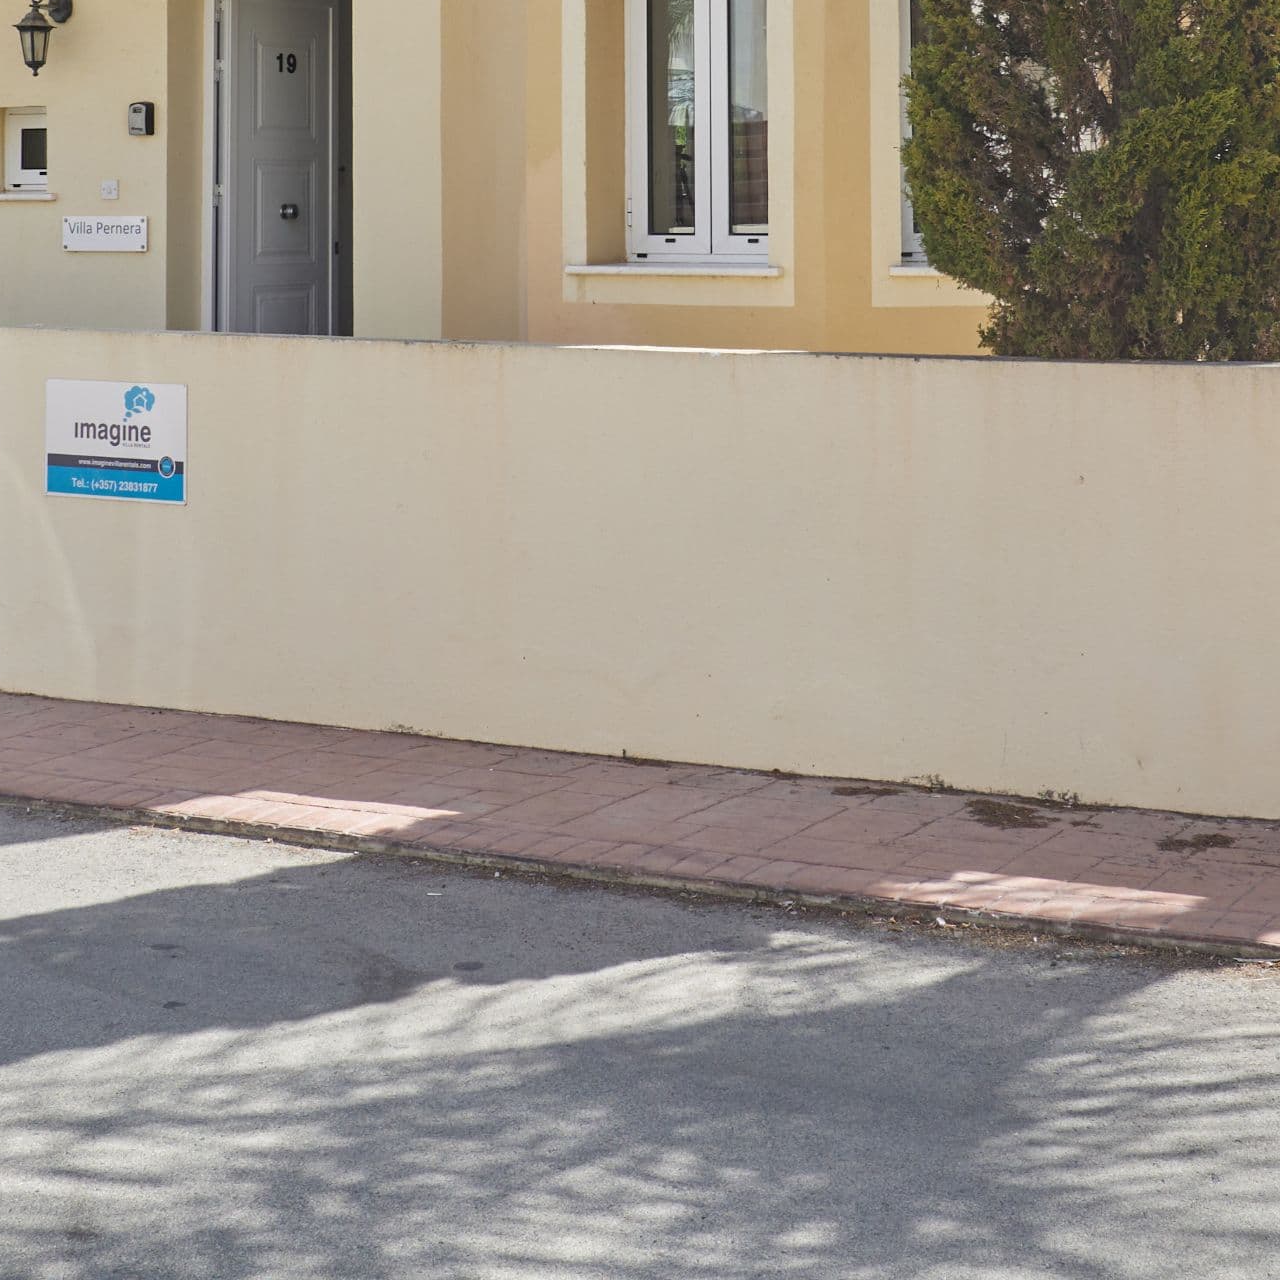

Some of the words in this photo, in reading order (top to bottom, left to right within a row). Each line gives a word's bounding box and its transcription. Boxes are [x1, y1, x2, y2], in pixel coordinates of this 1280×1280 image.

[276, 52, 297, 74] 19
[68, 221, 93, 235] Villa
[96, 222, 142, 235] Pernera
[74, 422, 152, 447] imagine
[91, 479, 117, 492] (+357)
